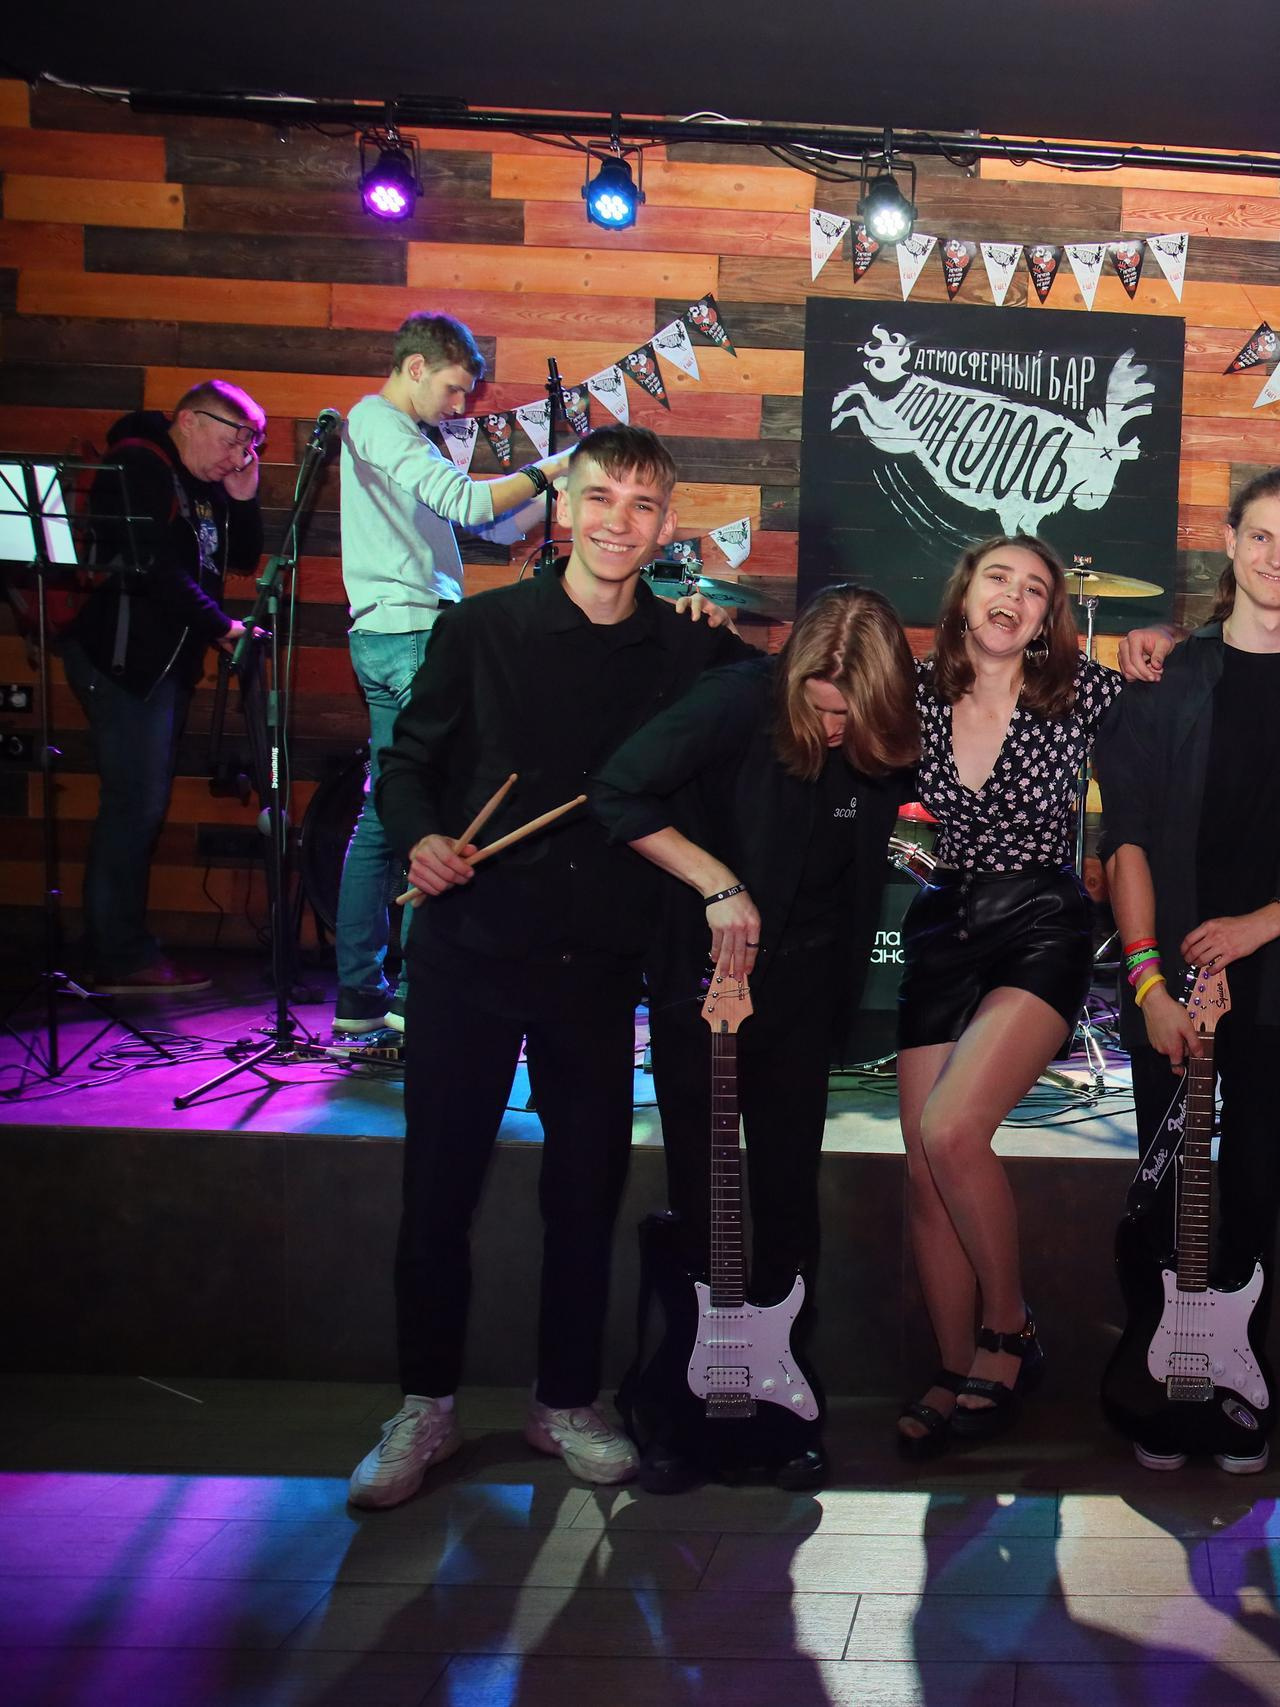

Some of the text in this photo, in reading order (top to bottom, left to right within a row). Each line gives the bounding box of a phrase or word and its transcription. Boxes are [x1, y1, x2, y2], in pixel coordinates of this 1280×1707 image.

[914, 349, 1096, 410] АТМОСФЕРНЫЙ БАР
[895, 382, 1073, 504] ПОНЕСЛОСЬ
